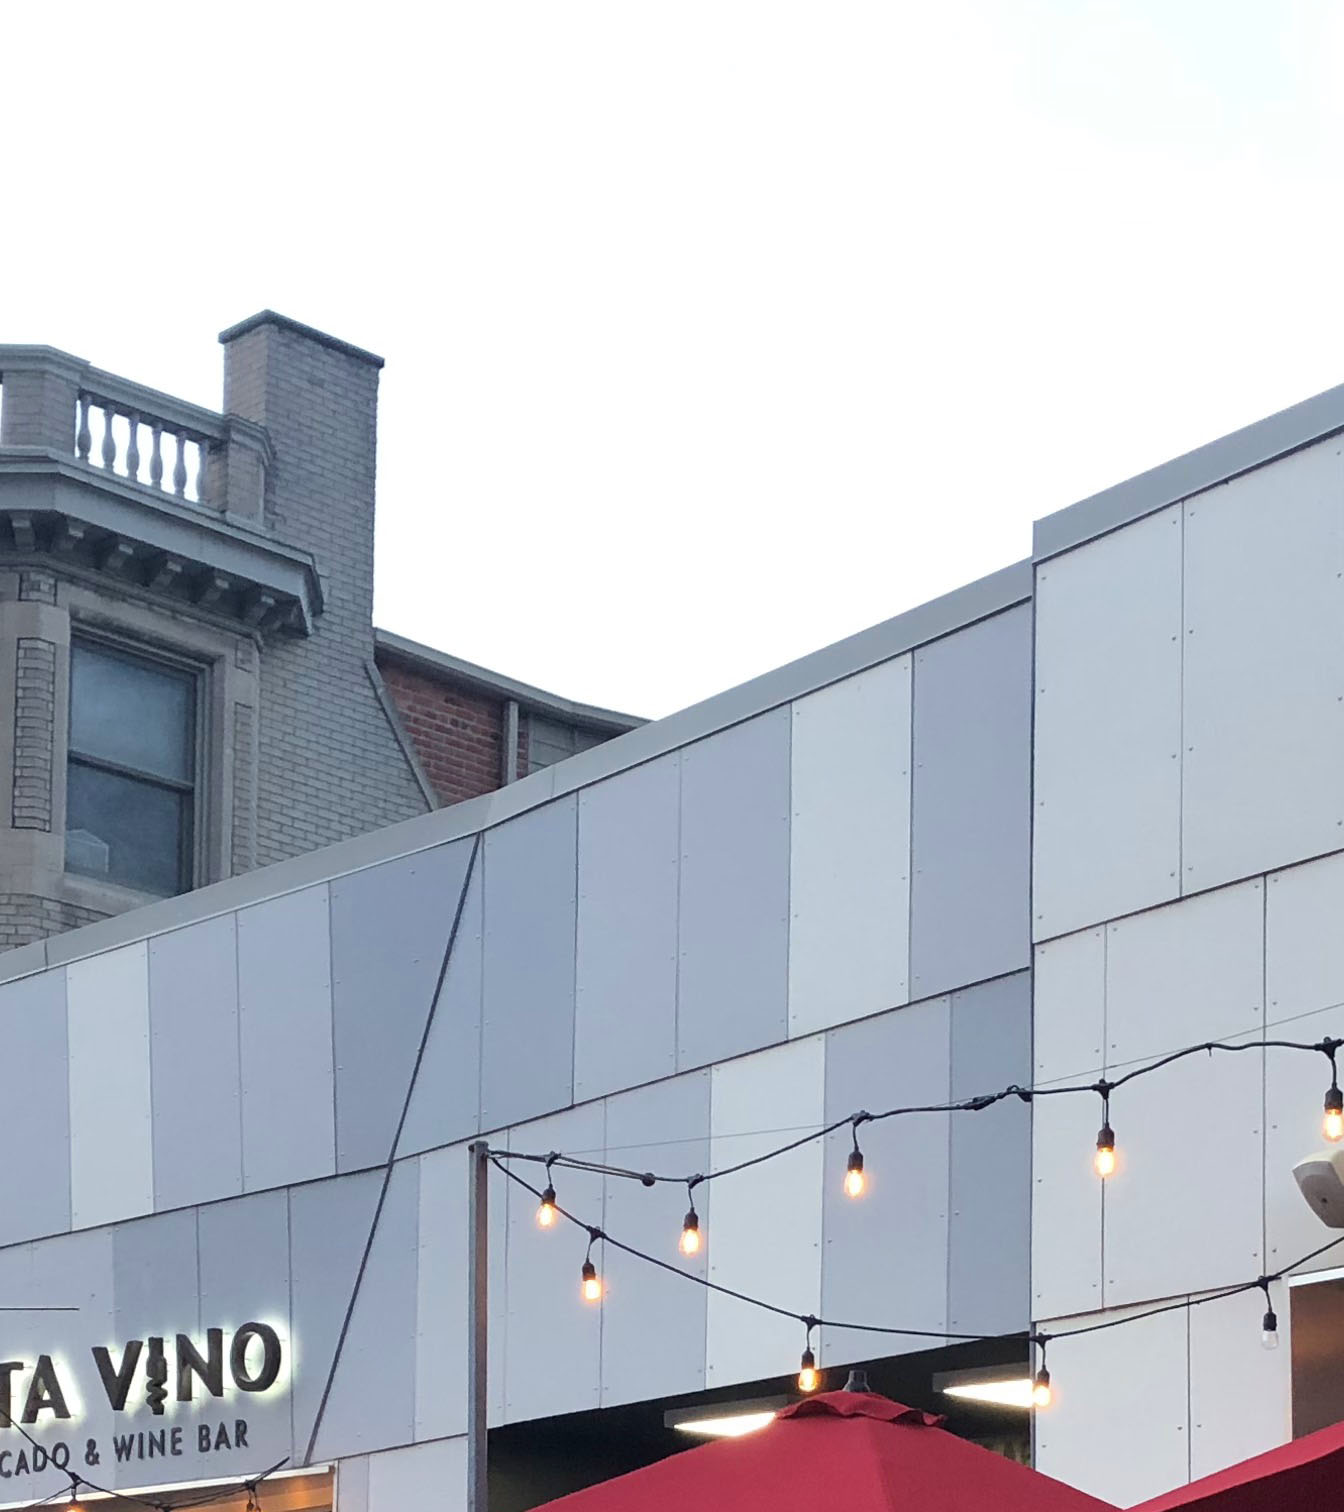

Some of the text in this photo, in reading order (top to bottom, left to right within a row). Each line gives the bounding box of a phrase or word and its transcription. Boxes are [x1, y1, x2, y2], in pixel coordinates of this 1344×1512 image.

[91, 1321, 282, 1415] VINO
[84, 1438, 100, 1466] &
[113, 1427, 183, 1463] WINE
[197, 1419, 249, 1453] BAR
